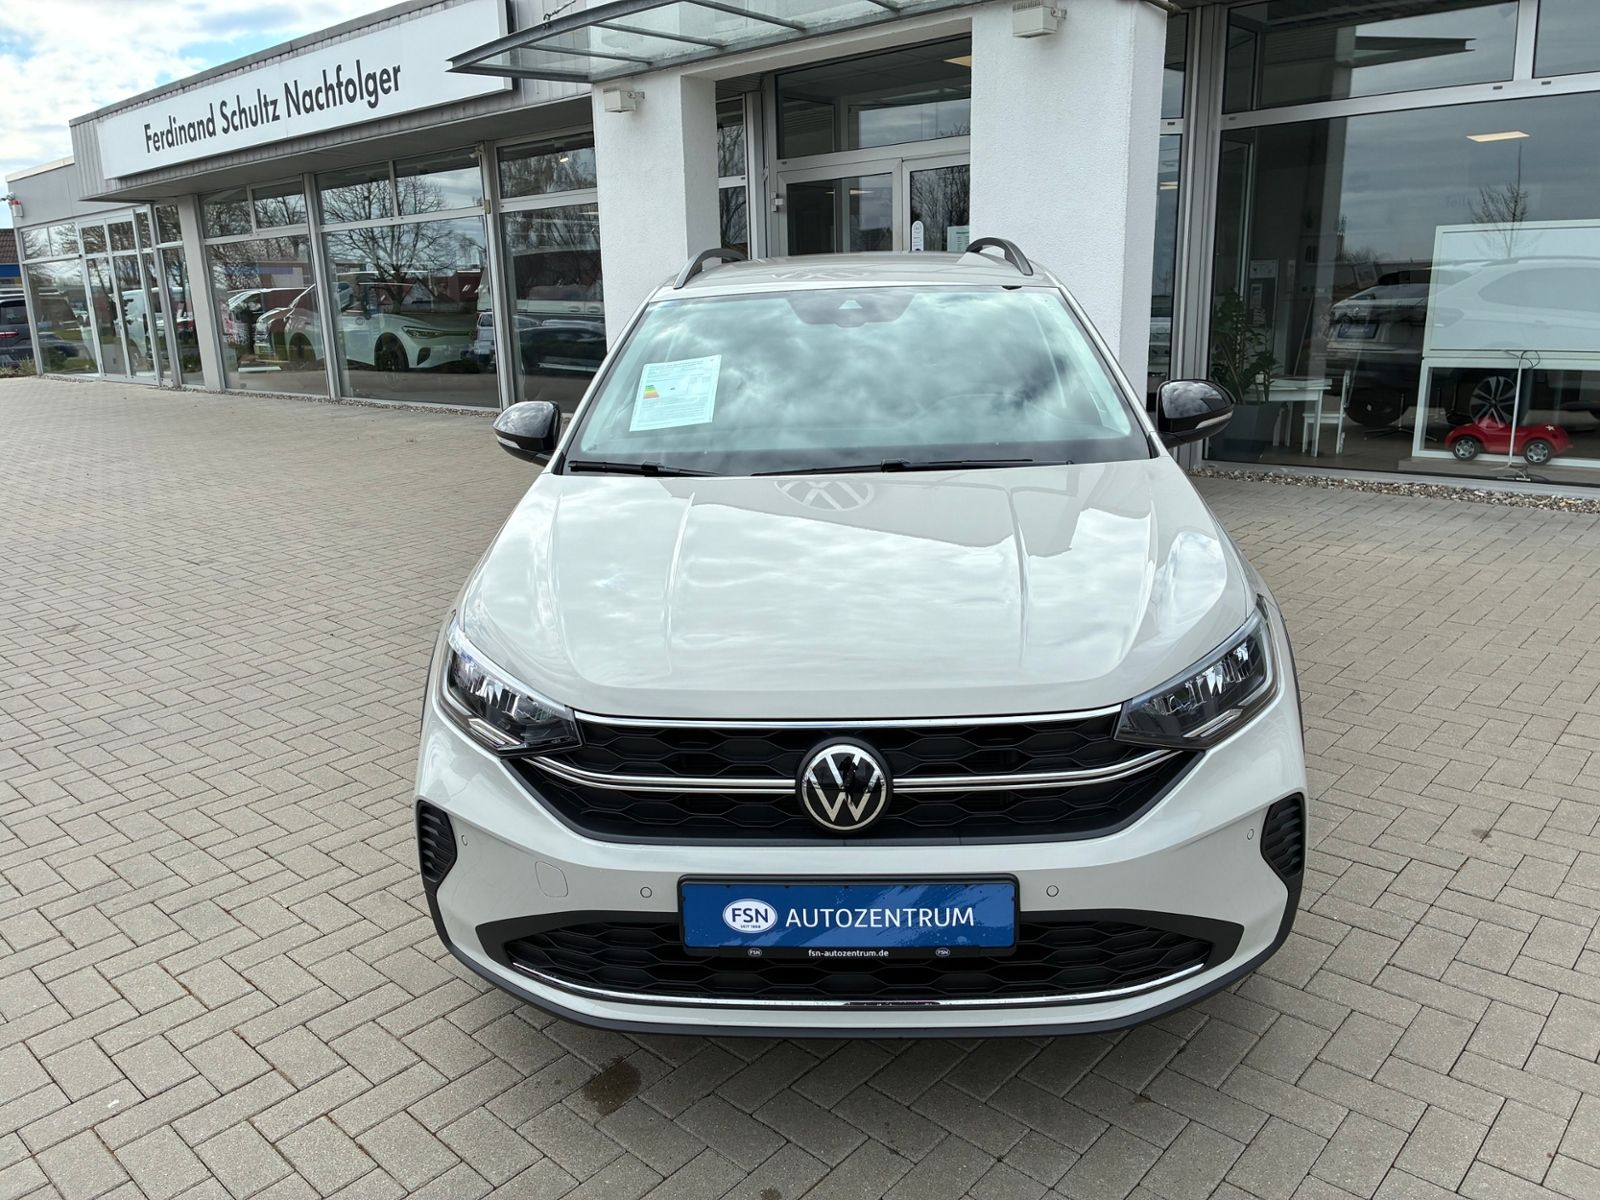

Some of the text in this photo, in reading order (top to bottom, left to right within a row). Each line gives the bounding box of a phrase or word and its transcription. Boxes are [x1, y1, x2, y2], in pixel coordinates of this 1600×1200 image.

[144, 59, 401, 153] Ferdinand Schultz Nachfolger
[804, 747, 884, 827] VW
[731, 907, 975, 929] FSN AUTOZENTRUM
[808, 948, 890, 958] fsn-autozentrum.de
